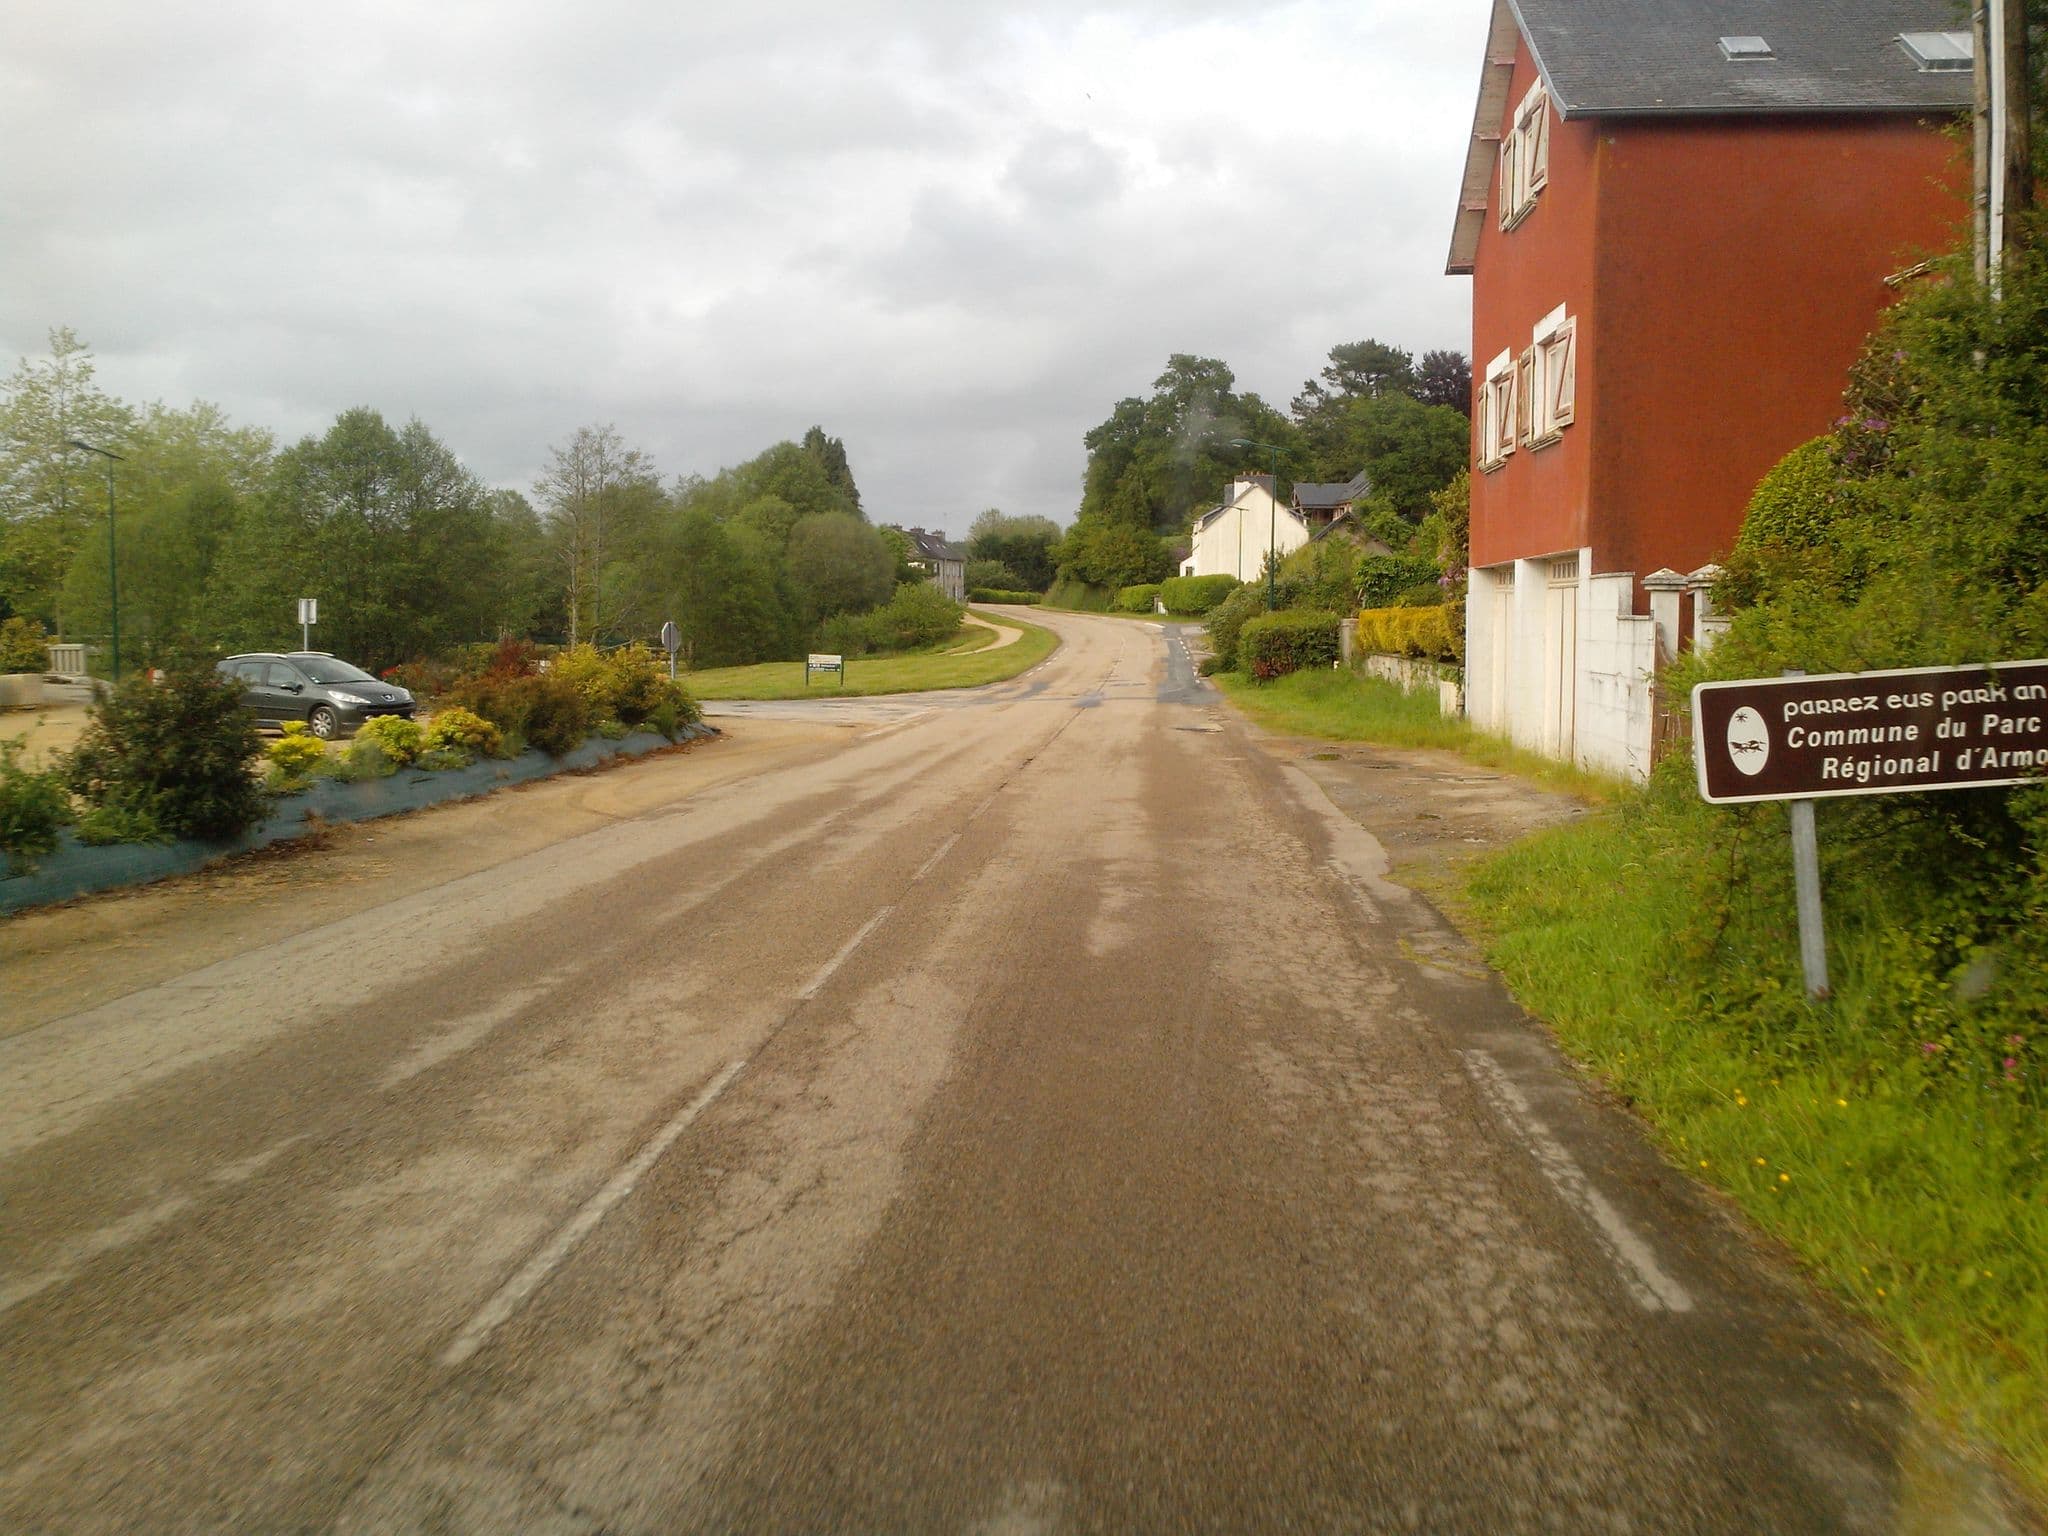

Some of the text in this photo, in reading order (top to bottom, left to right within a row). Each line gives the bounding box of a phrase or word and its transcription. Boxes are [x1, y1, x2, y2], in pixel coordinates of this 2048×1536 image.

[1886, 692, 1935, 709] eus
[2013, 684, 2048, 701] an
[1787, 714, 2041, 749] Commune du Parc
[1822, 750, 1940, 783] Régional
